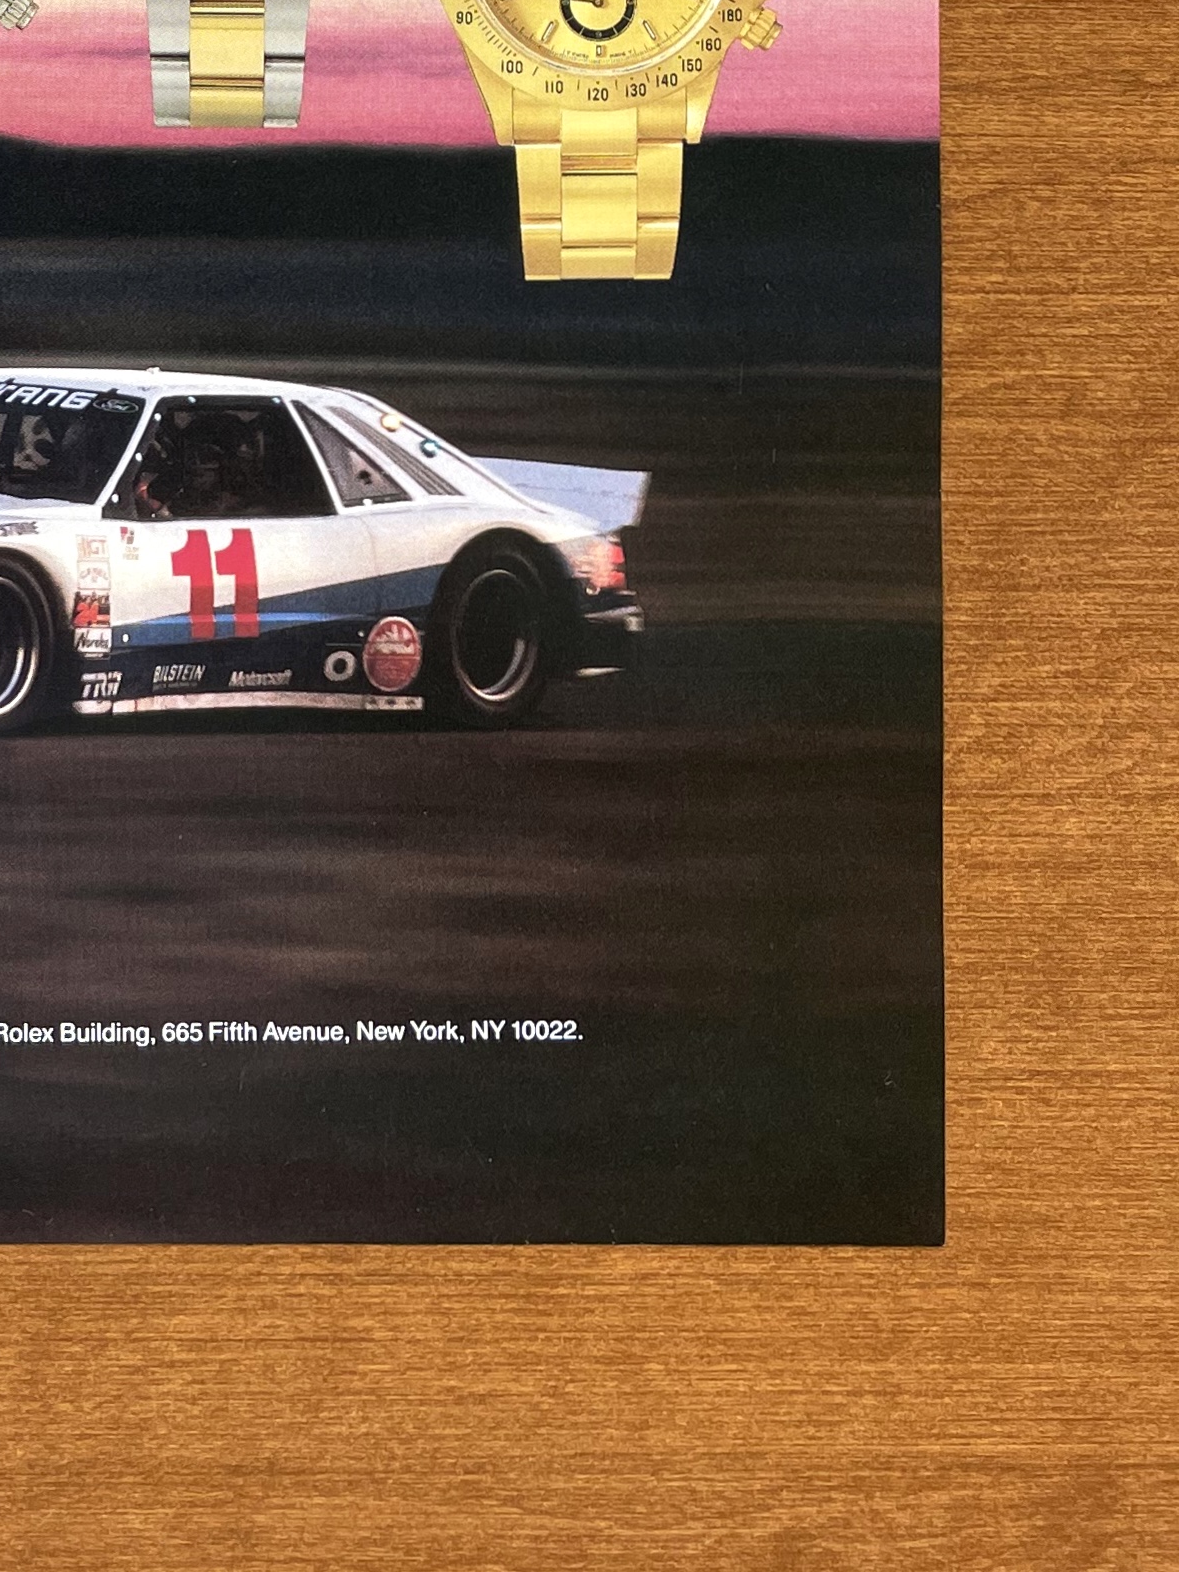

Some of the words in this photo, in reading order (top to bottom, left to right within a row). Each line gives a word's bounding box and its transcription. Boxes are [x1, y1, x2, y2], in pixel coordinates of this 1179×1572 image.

[171, 528, 260, 639] 11
[153, 664, 206, 683] BILSTEIN
[59, 1021, 156, 1048] Building,
[161, 1021, 204, 1043] 665
[208, 1021, 258, 1042] Fifth
[262, 1020, 350, 1045] Avenue,
[356, 1020, 406, 1042] New
[409, 1019, 465, 1044] York,
[471, 1019, 507, 1041] NY
[510, 1019, 584, 1041] 10022.
